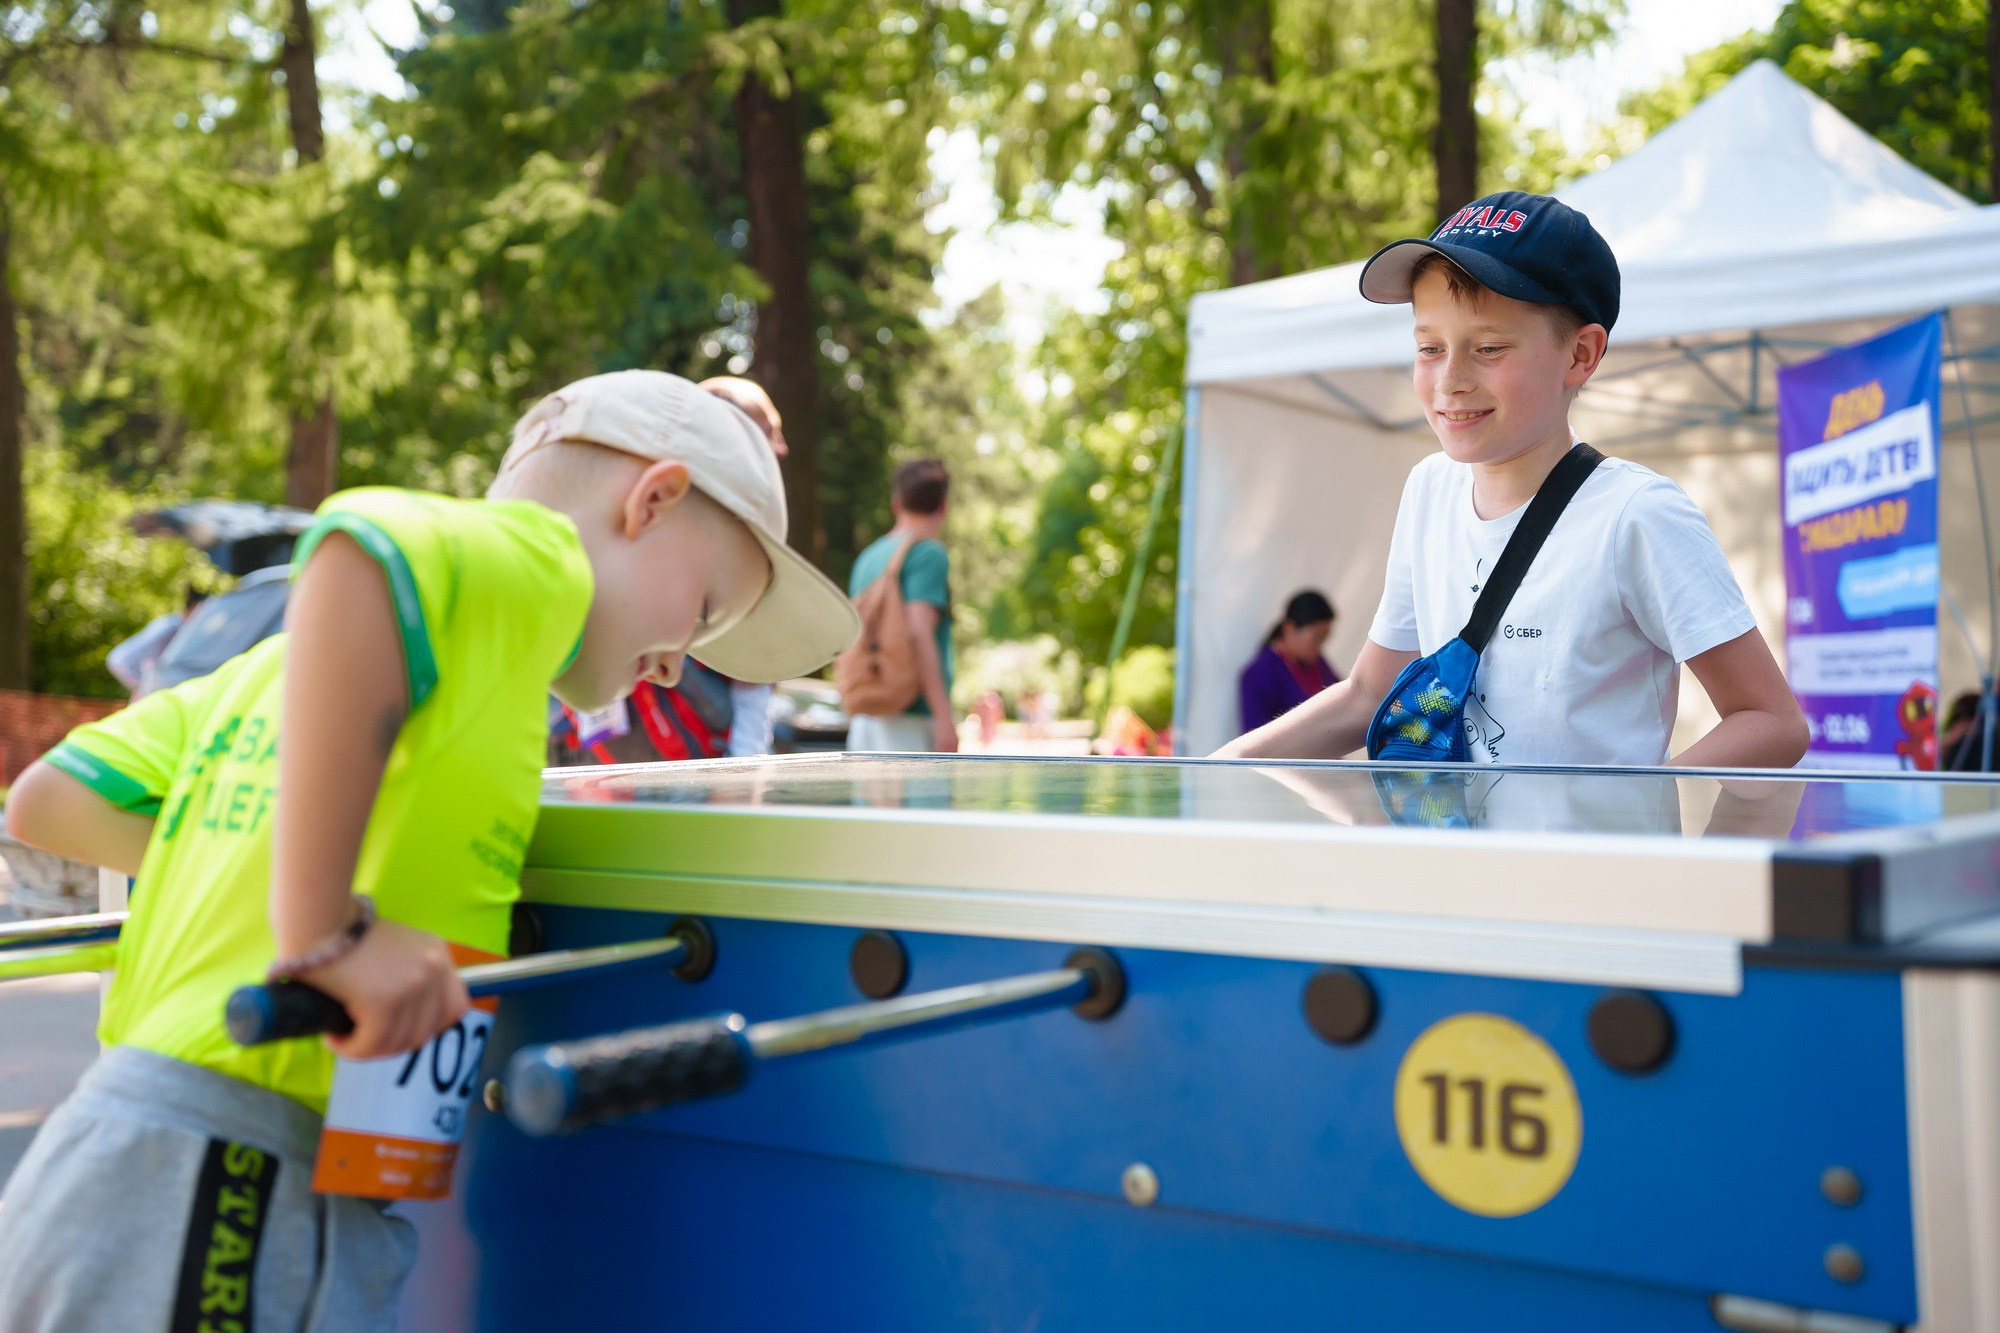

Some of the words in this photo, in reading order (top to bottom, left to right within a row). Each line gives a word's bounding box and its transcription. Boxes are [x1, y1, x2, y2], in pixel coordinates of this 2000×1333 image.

[1437, 206, 1527, 232] YALS
[1516, 628, 1542, 638] СБЕР
[1421, 1072, 1549, 1159] 116
